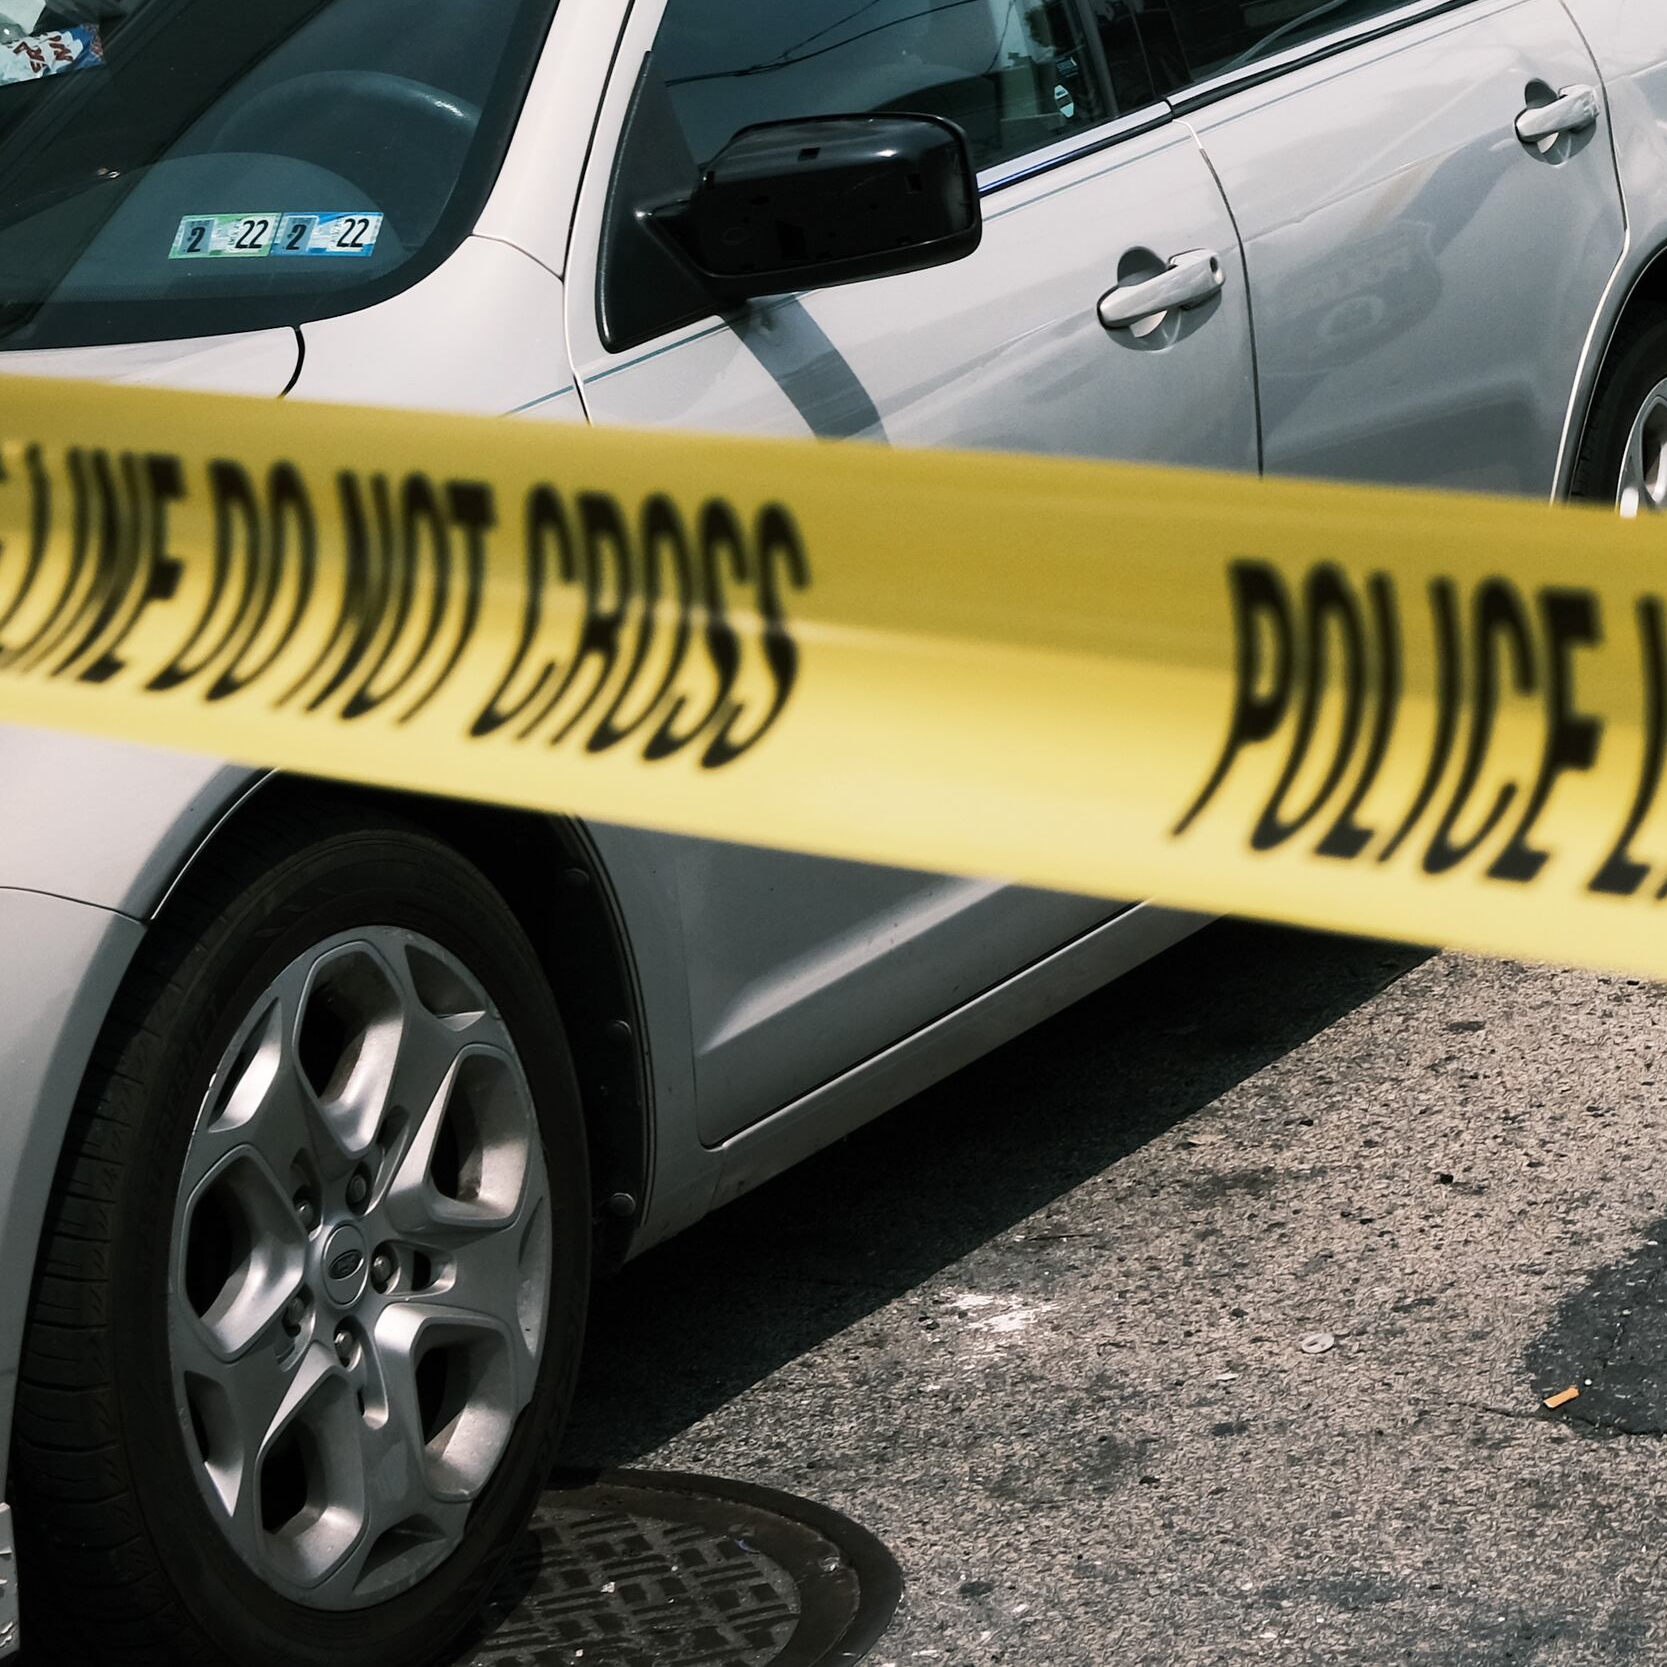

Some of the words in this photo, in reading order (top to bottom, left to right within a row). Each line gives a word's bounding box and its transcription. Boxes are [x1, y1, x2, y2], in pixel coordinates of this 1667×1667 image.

[187, 226, 206, 253] 2
[234, 219, 269, 249] 22
[286, 224, 307, 251] 2
[336, 218, 370, 248] 22
[0, 442, 188, 683] LINE
[145, 456, 318, 702] DO
[274, 466, 498, 724] NOT
[467, 481, 811, 771] CROSS
[1172, 558, 1605, 883] POLICE
